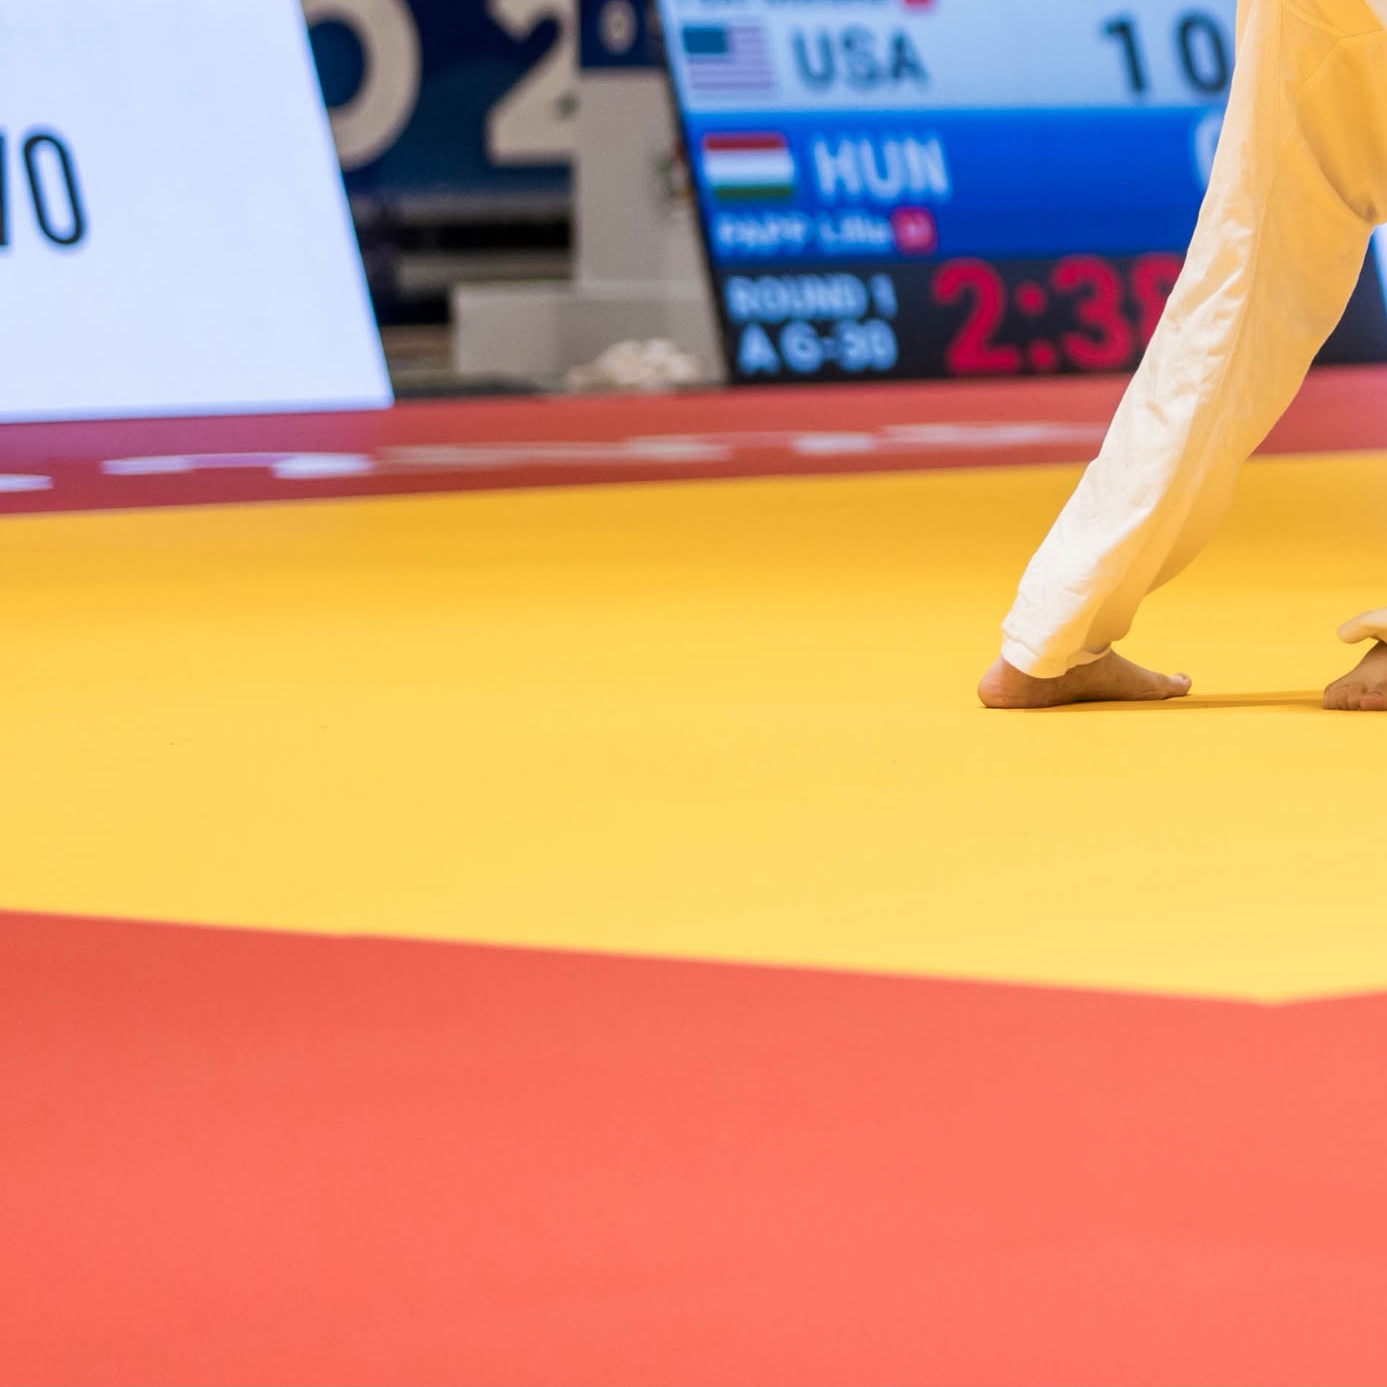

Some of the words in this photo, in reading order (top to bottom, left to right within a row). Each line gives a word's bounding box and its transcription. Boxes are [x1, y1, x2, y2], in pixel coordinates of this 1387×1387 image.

[790, 24, 931, 93] USA
[811, 132, 951, 201] HUN
[724, 273, 868, 323] ROUND
[868, 272, 898, 320] 1
[737, 321, 781, 375] A
